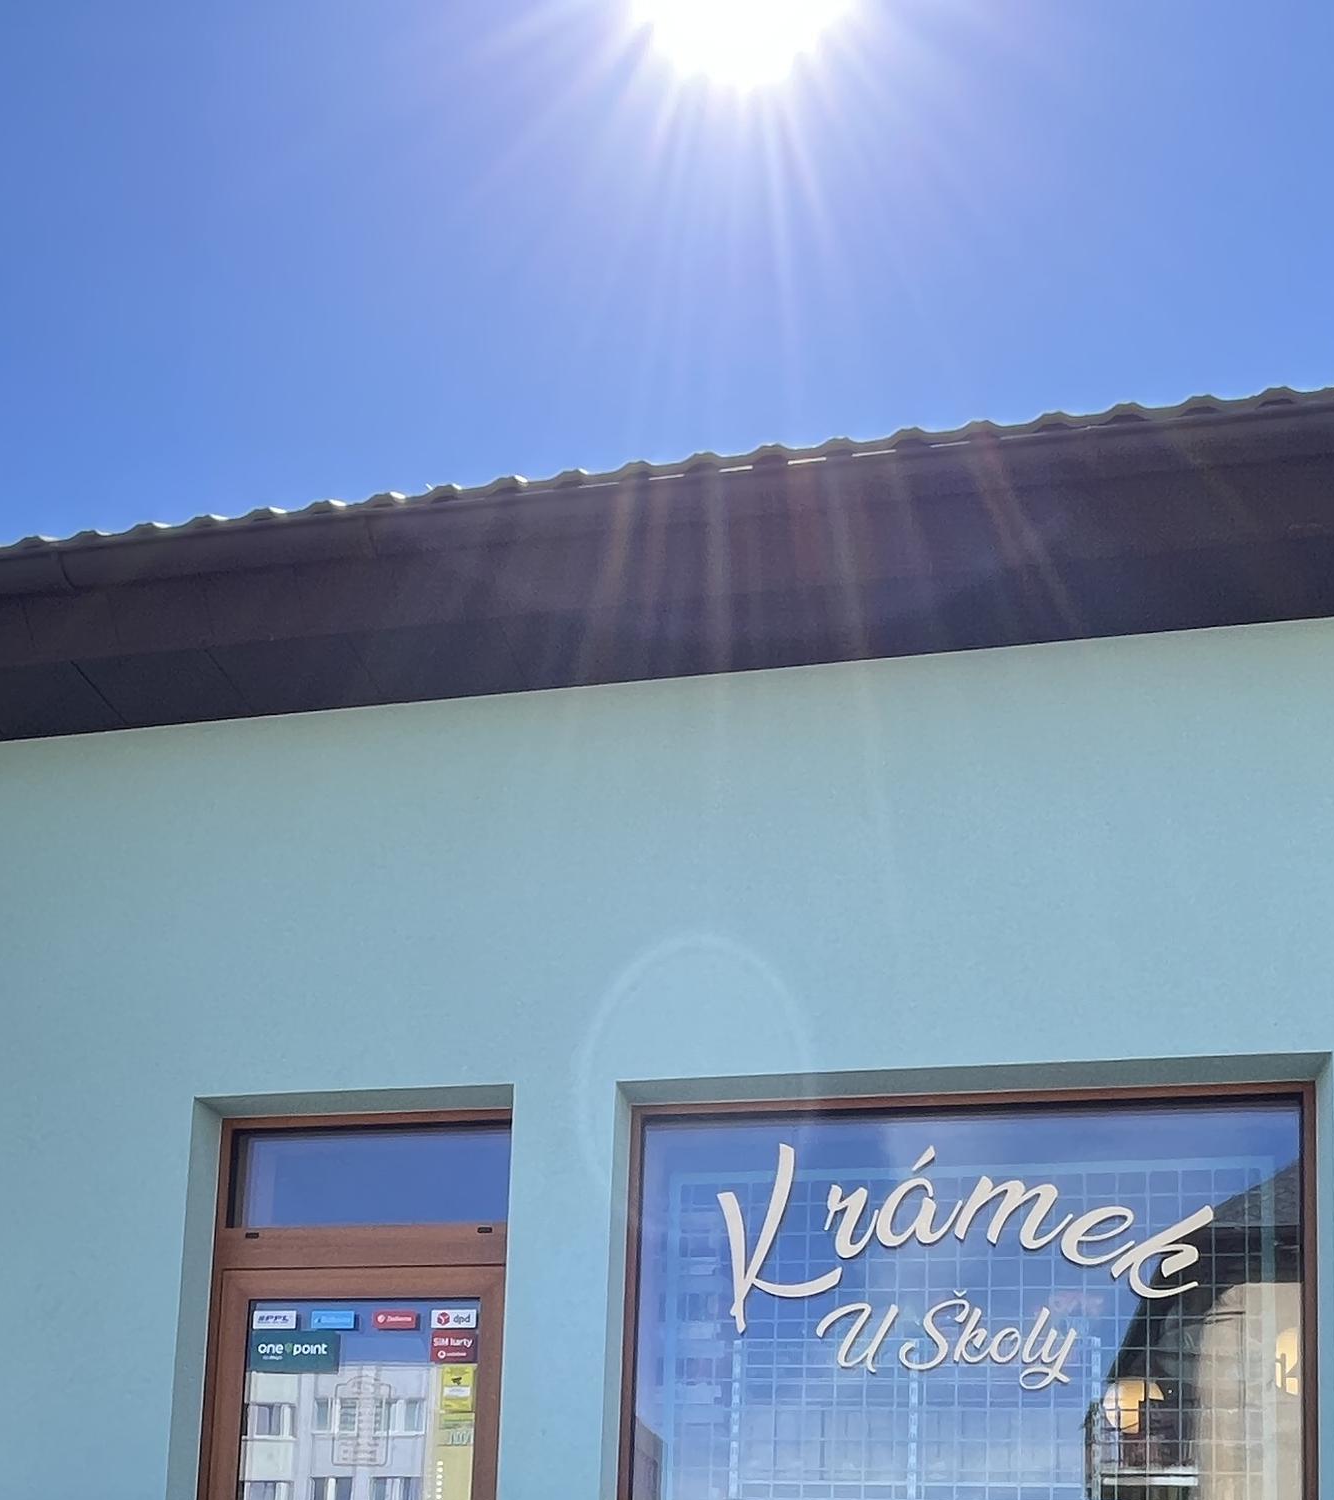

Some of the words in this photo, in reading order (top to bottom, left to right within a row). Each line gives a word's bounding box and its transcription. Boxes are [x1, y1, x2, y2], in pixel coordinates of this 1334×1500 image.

[717, 1143, 1214, 1333] Krámek
[453, 1314, 471, 1324] dpd
[816, 1302, 899, 1373] U
[899, 1289, 1078, 1390] Školy
[258, 1343, 284, 1355] one
[292, 1343, 328, 1356] point
